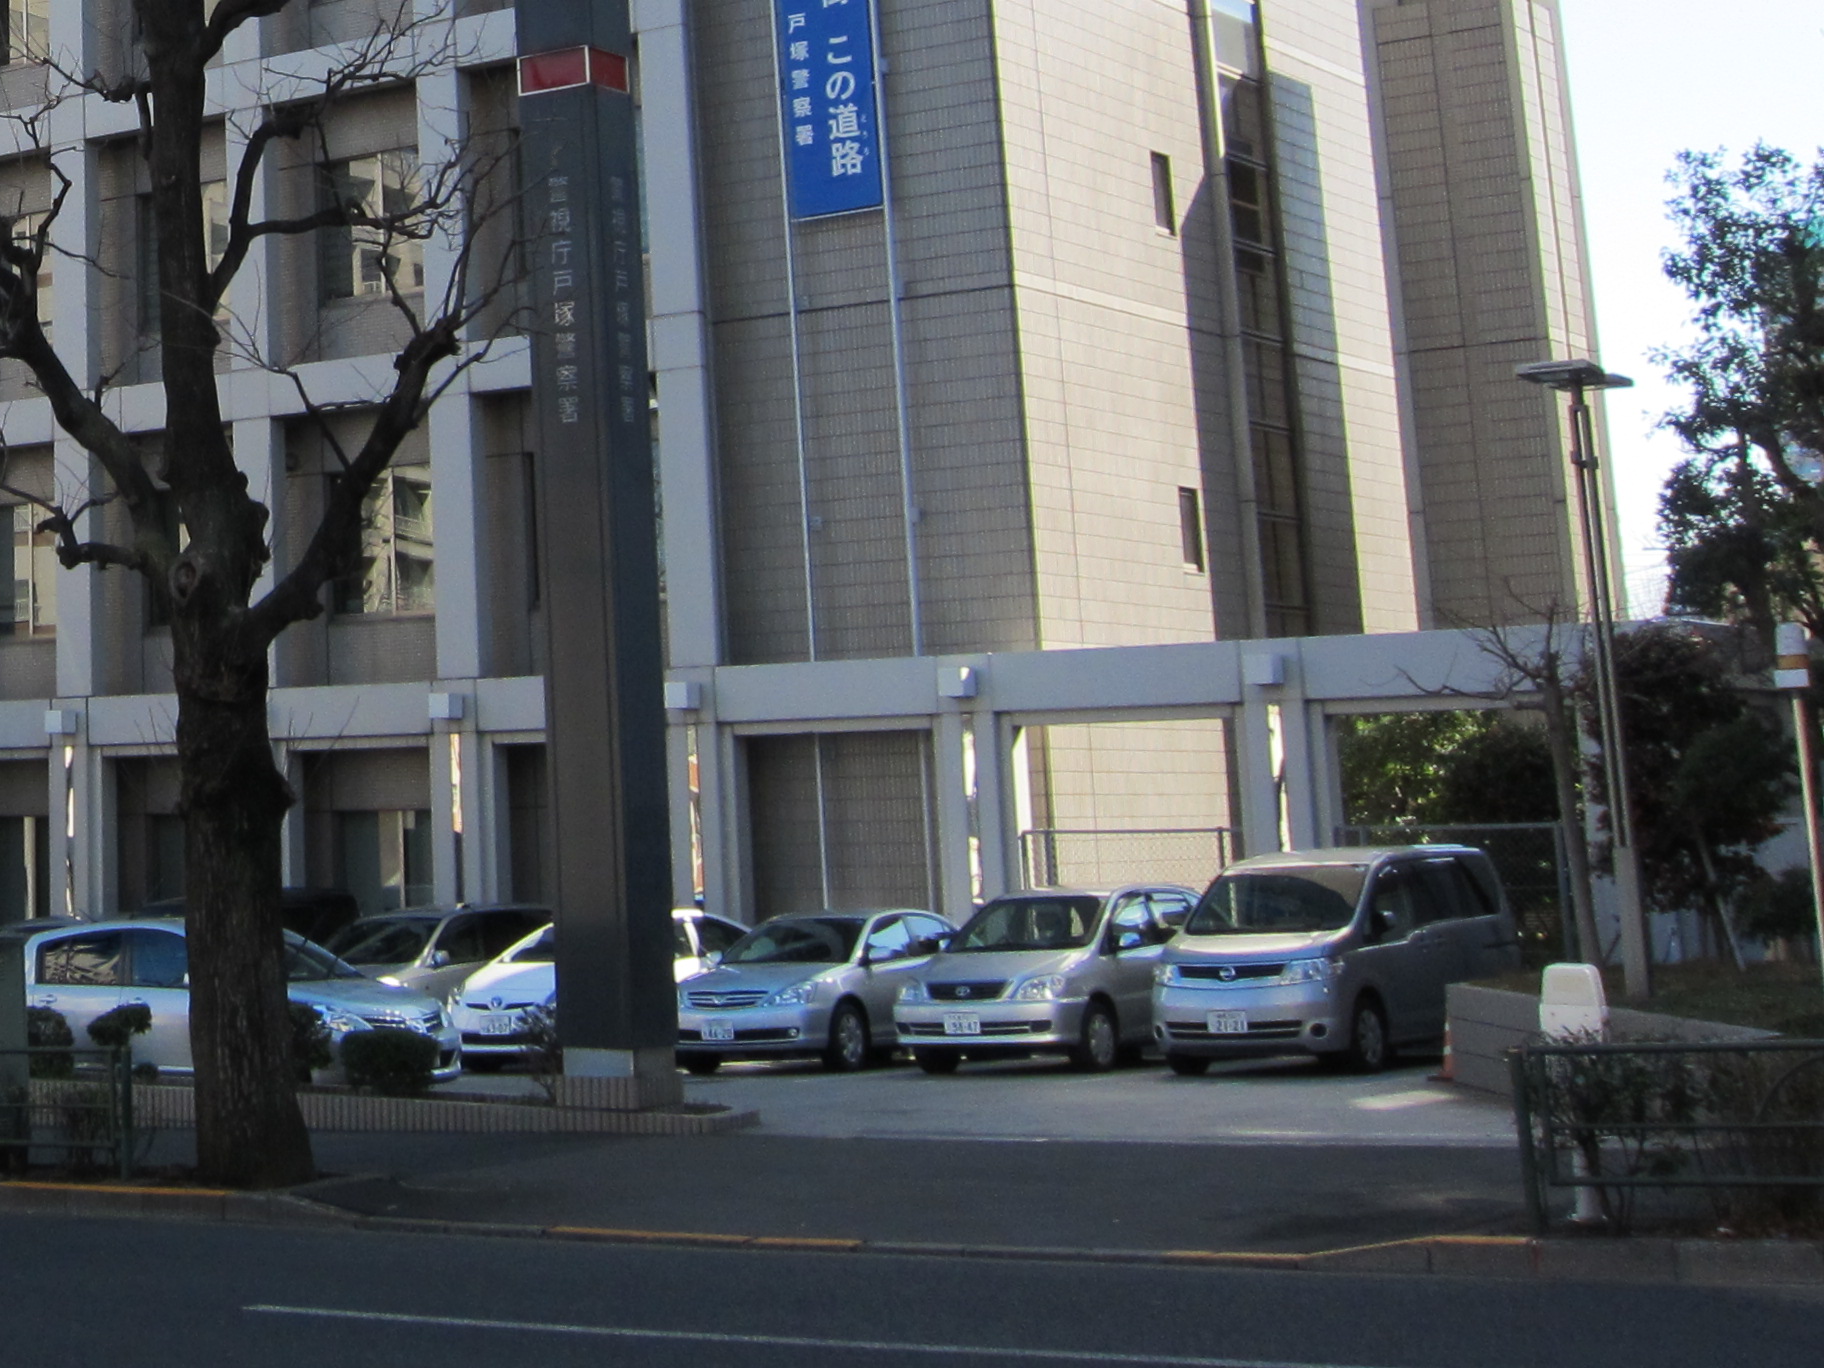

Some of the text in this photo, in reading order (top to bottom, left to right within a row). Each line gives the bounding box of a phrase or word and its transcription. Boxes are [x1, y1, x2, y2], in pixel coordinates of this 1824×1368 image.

[787, 12, 815, 147] 戸塚警察署
[826, 34, 865, 178] この道路
[549, 176, 578, 423] 警視庁戸塚警察署
